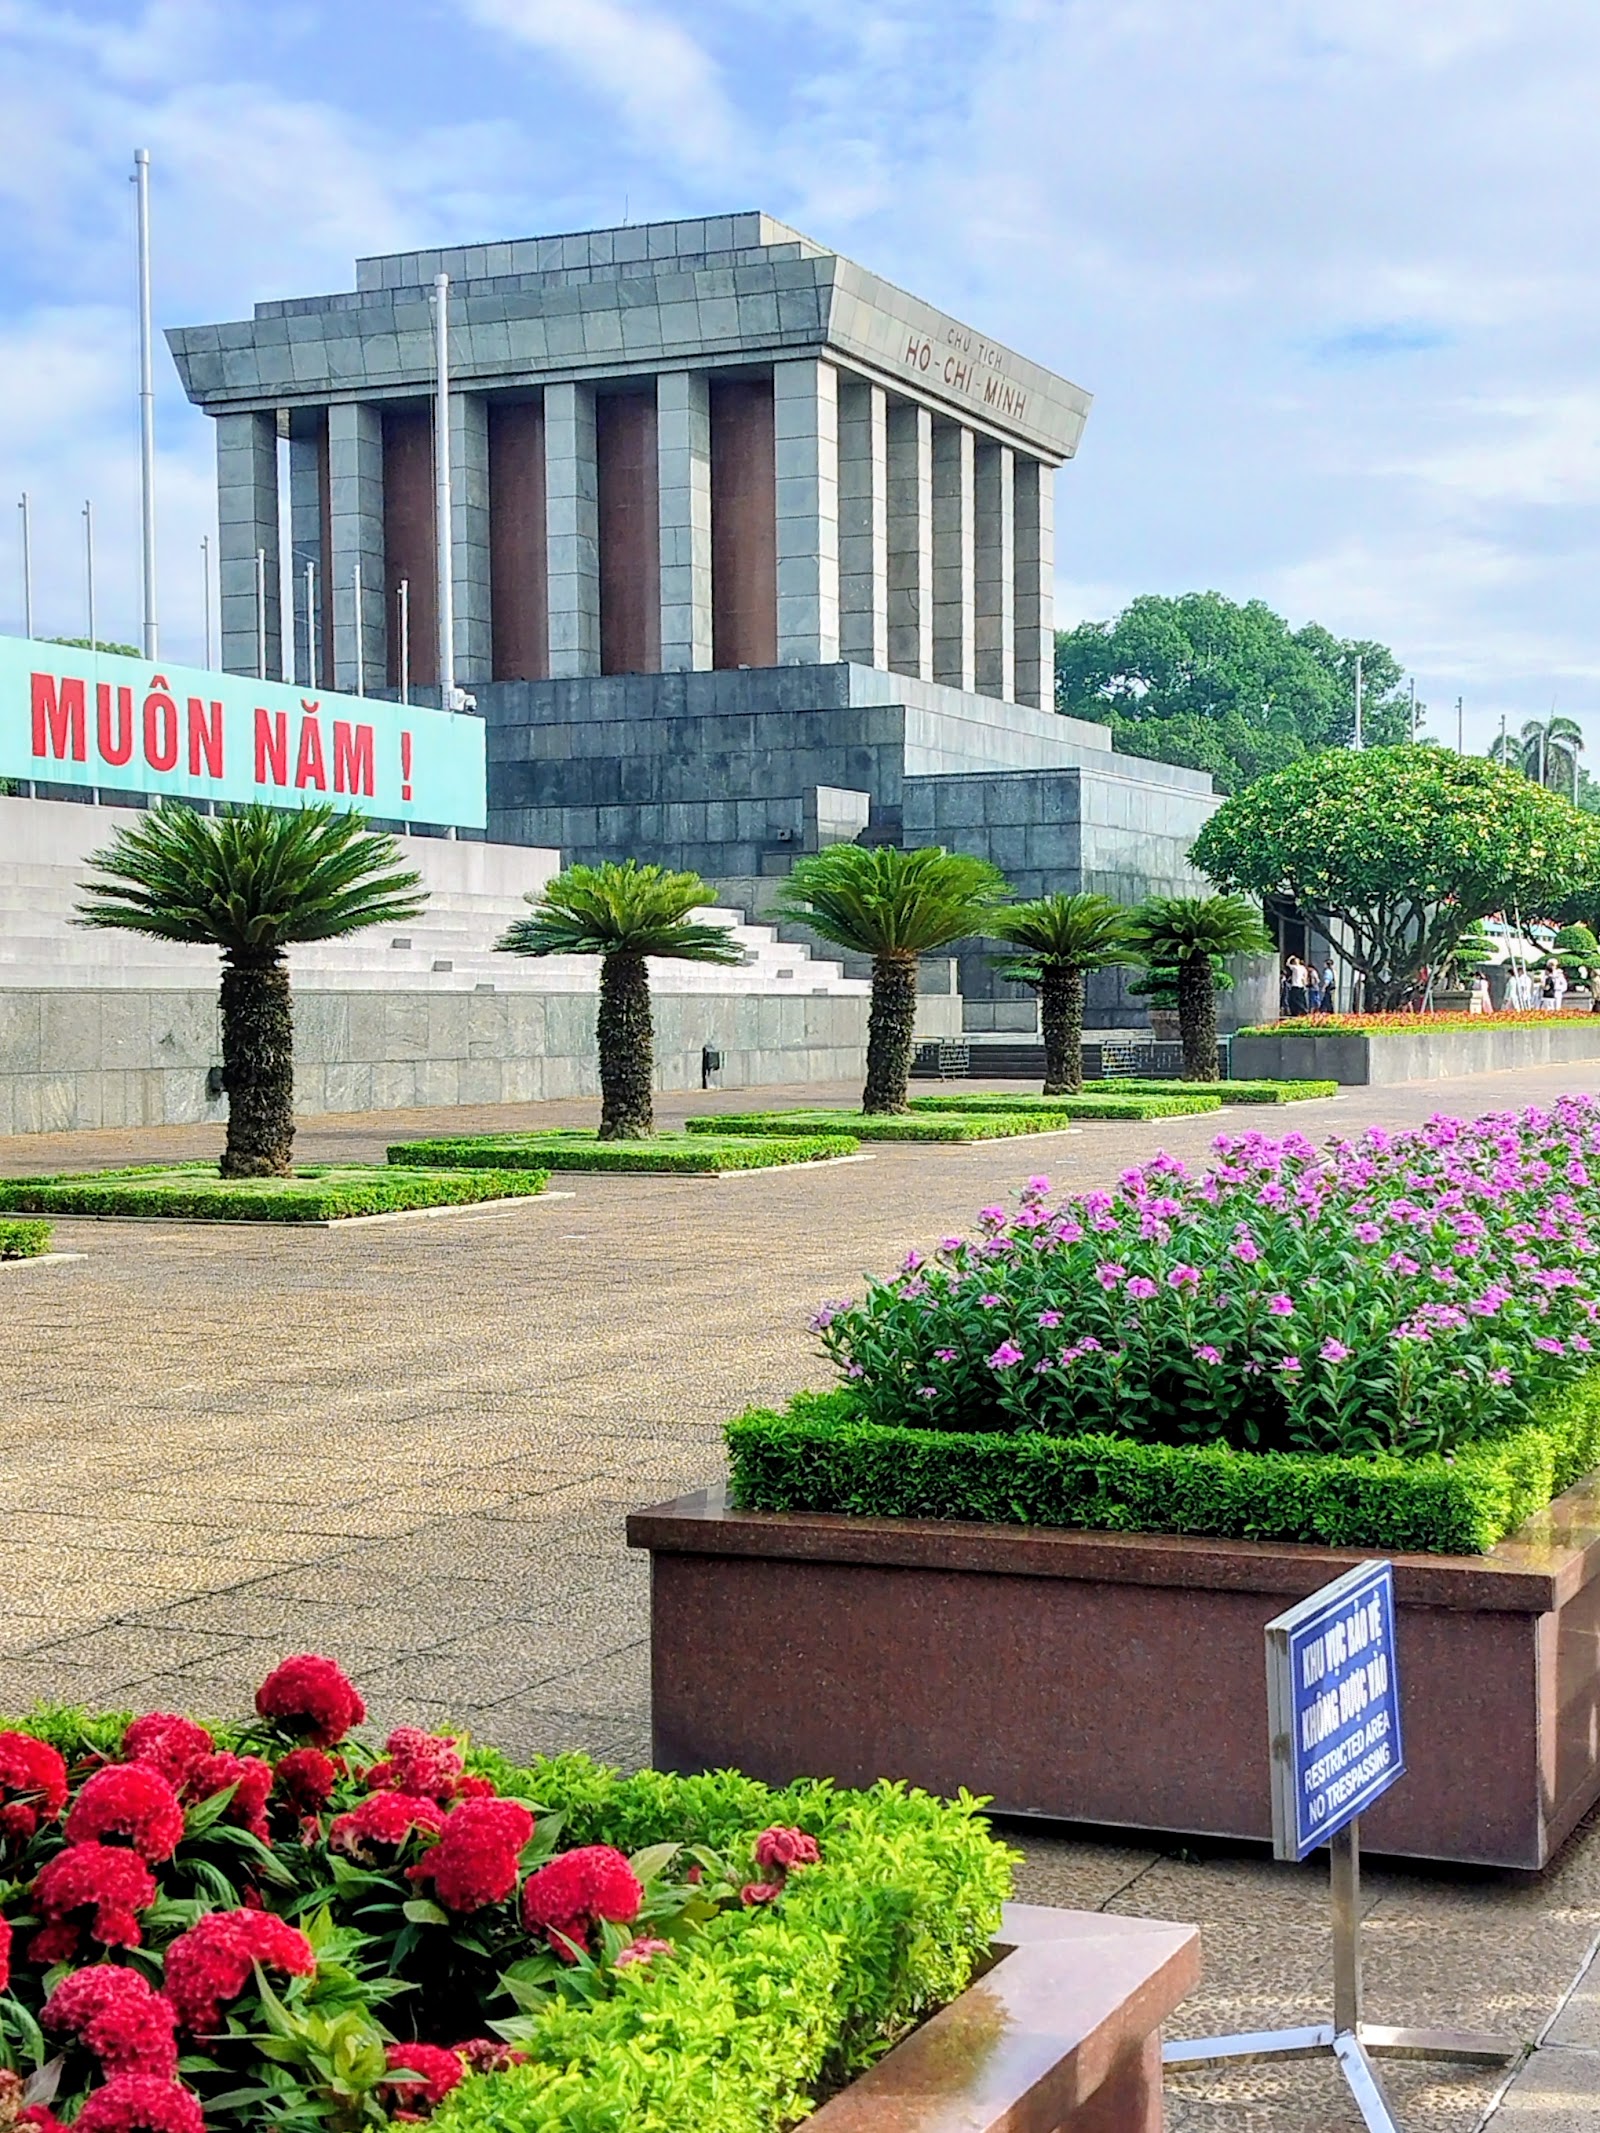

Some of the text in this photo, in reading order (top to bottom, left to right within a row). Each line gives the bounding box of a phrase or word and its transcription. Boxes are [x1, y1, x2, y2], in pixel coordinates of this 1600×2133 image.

[30, 672, 224, 779] MUÔN
[254, 699, 374, 797] NĂM
[1302, 1589, 1382, 1690] KHU VỰC BẢO VỆ
[1302, 1650, 1388, 1752] KHÔNG ĐƯỢC VÀO
[1304, 1709, 1391, 1795] RESTRICTED AREA
[1308, 1741, 1391, 1826] NO TRESPASSING
